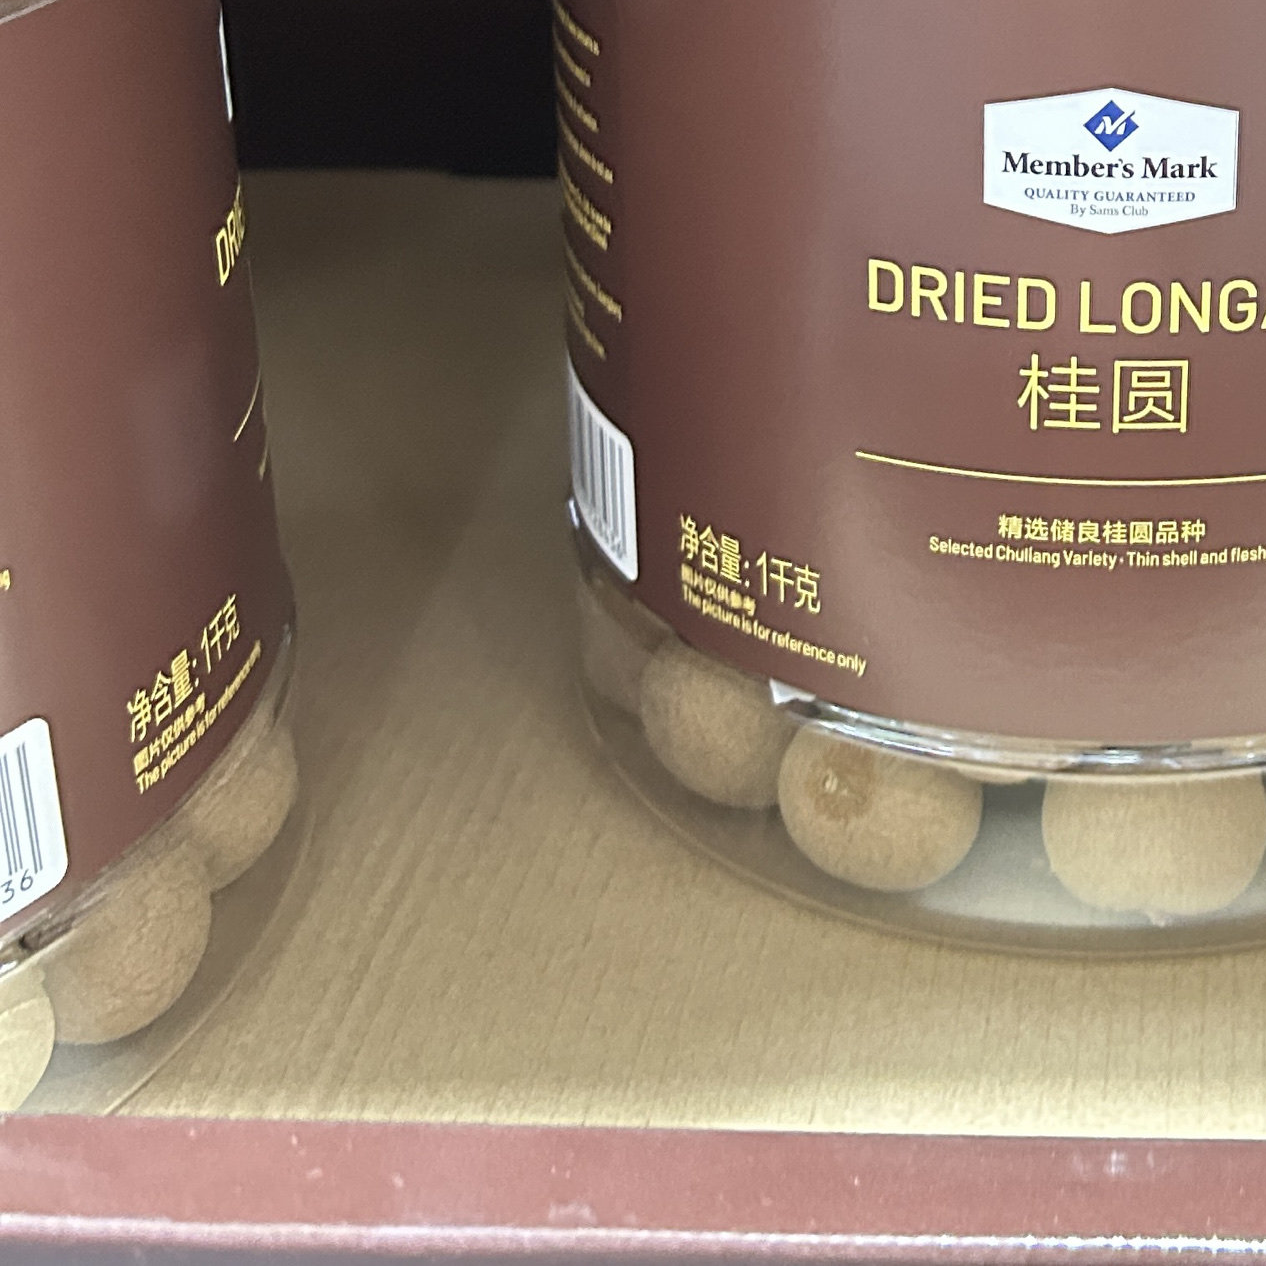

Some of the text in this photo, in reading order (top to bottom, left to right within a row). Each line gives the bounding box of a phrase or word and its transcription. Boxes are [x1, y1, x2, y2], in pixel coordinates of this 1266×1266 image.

[1002, 150, 1219, 180] Member's Mark
[1024, 187, 1196, 203] QUALITY GUARANTEED
[1070, 204, 1087, 217] By
[1122, 205, 1149, 217] Club
[867, 258, 1058, 332] DRIED
[1017, 352, 1190, 434] 桂圆
[998, 514, 1207, 545] 精选储良桂圆品种
[929, 536, 993, 560] Selected
[1063, 549, 1118, 571] Variety
[1126, 551, 1160, 568] Thin
[1163, 549, 1198, 567] shell
[1200, 547, 1228, 565] and
[702, 596, 741, 630] picture
[741, 614, 753, 635] is
[753, 618, 772, 642] for
[772, 630, 836, 665] reference
[837, 652, 867, 678] only
[160, 735, 198, 780] picture
